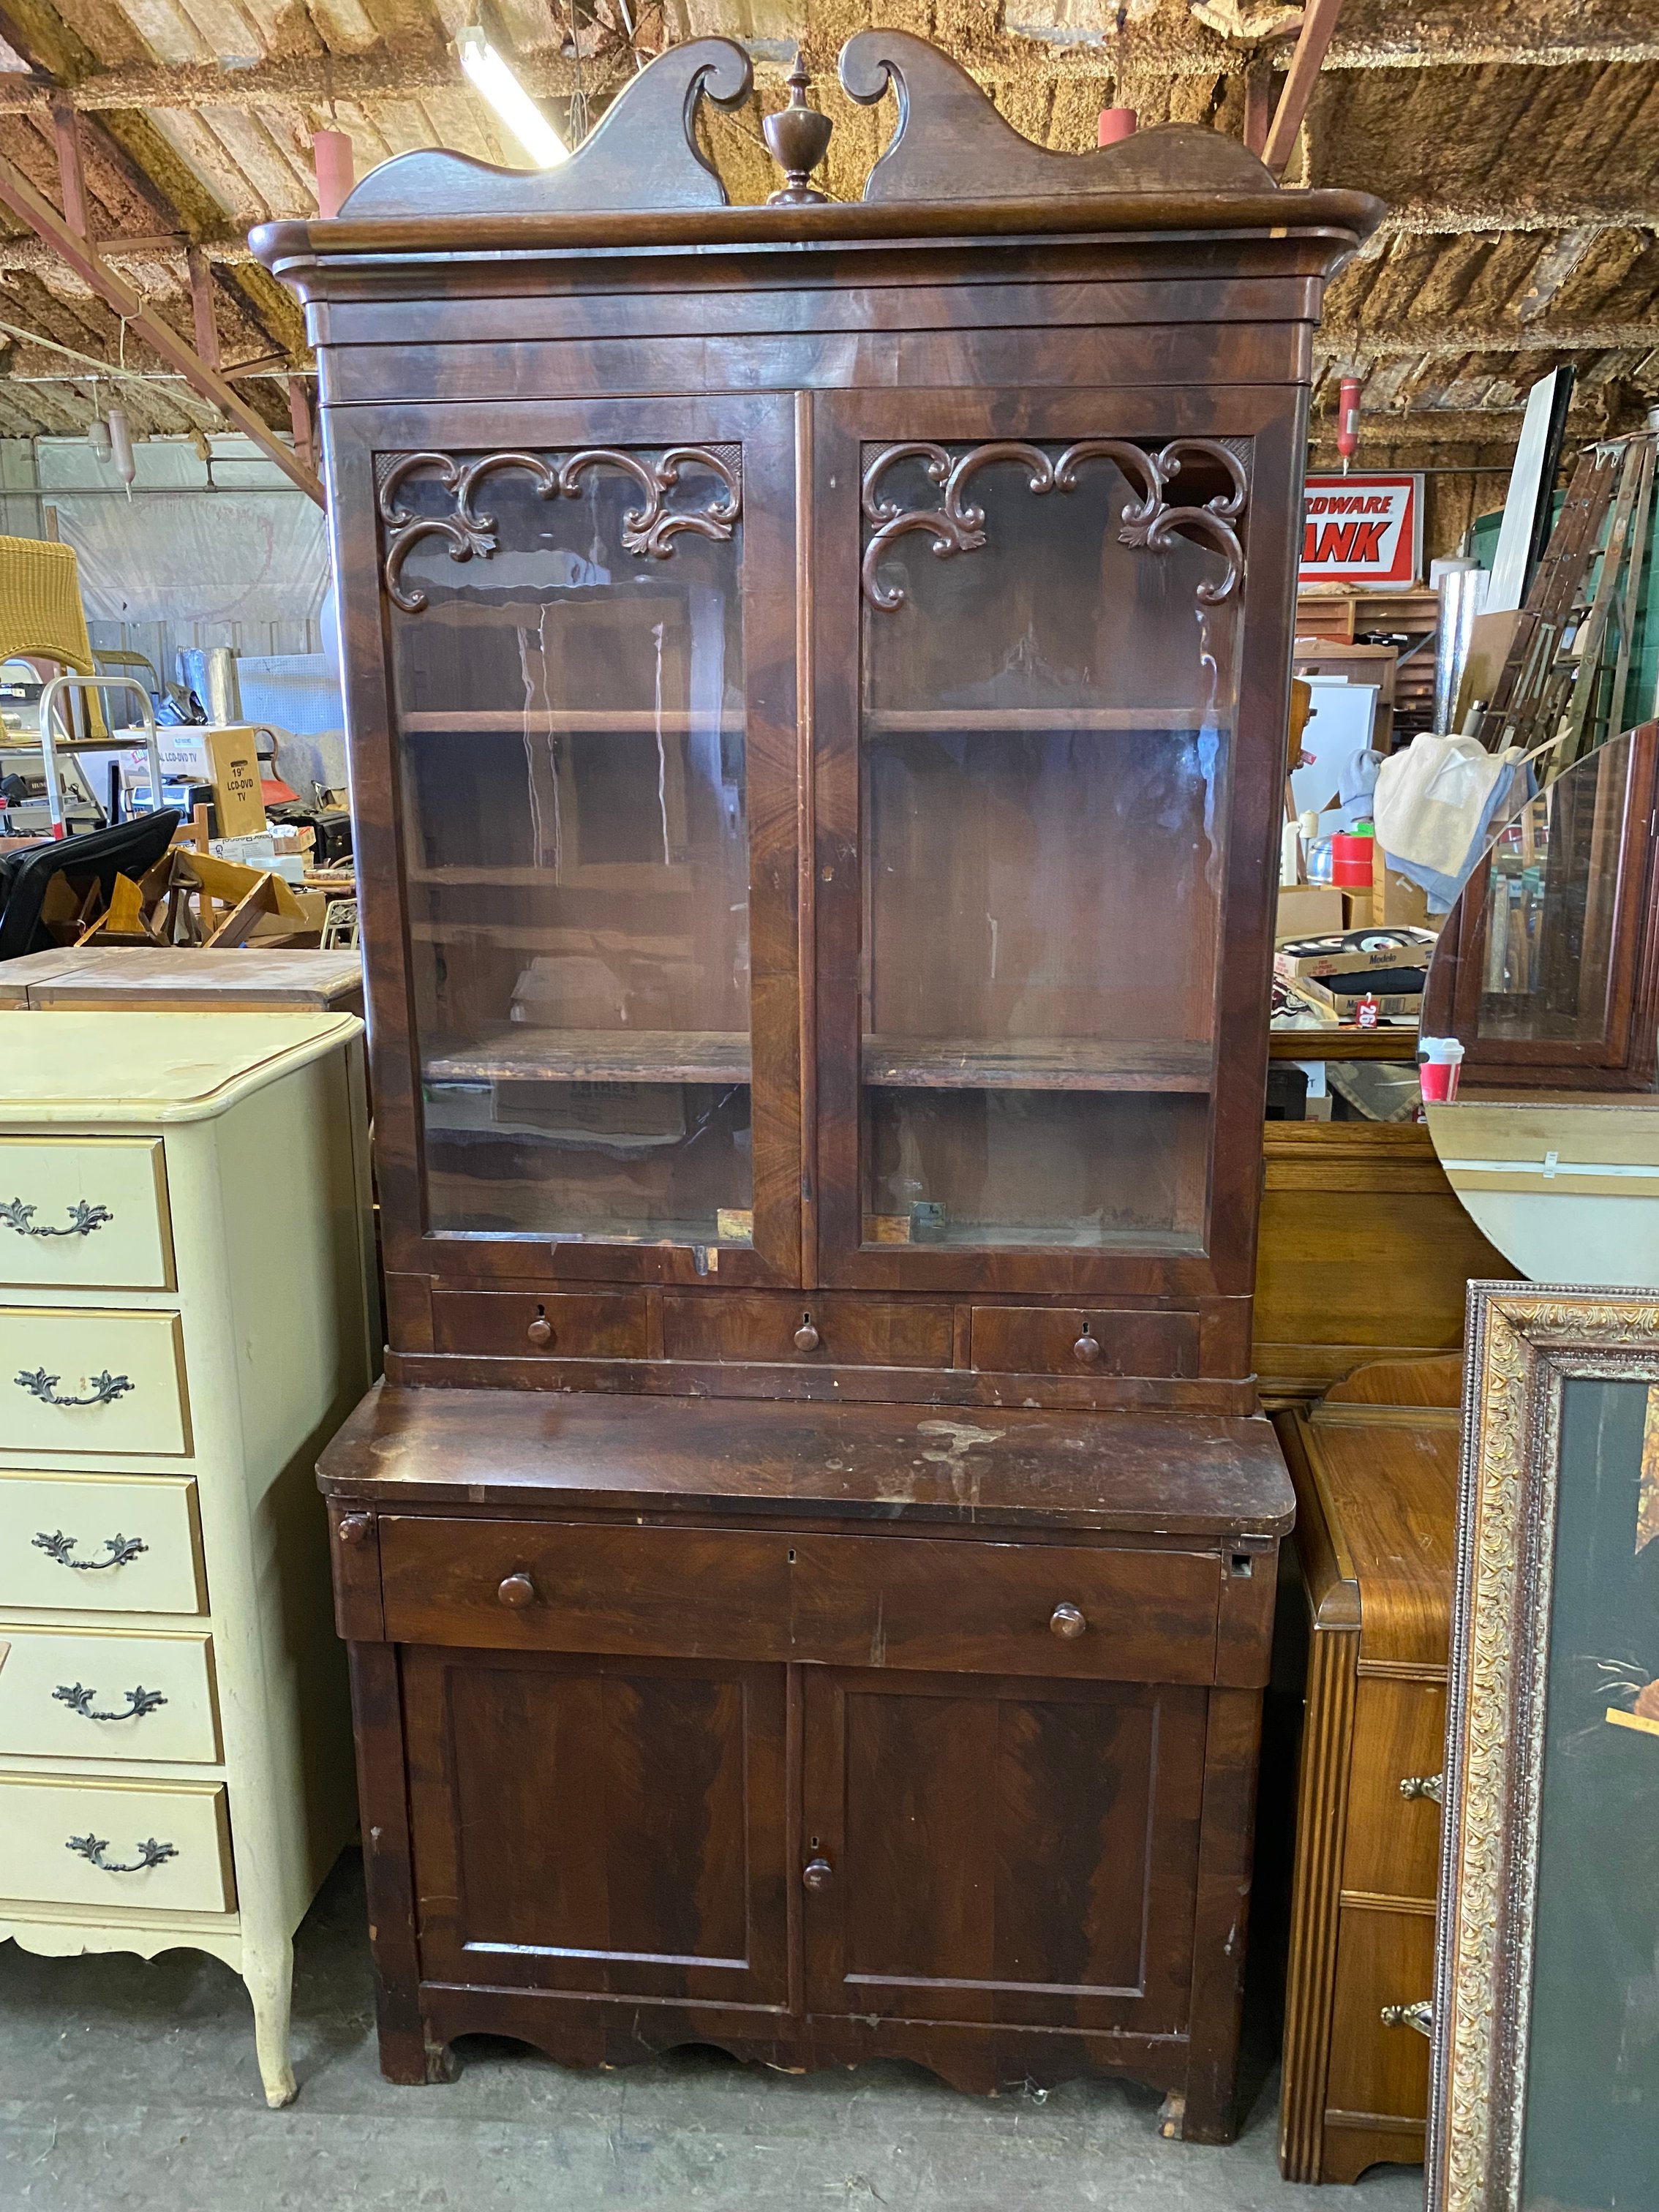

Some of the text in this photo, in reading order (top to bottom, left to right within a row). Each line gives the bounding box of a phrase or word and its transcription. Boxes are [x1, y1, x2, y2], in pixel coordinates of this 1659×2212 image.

[165, 752, 189, 761] LCD-DVD
[188, 753, 197, 762] TV
[227, 778, 254, 791] LCD-DVD
[237, 791, 246, 802] TV
[1369, 954, 1396, 965] Modelo
